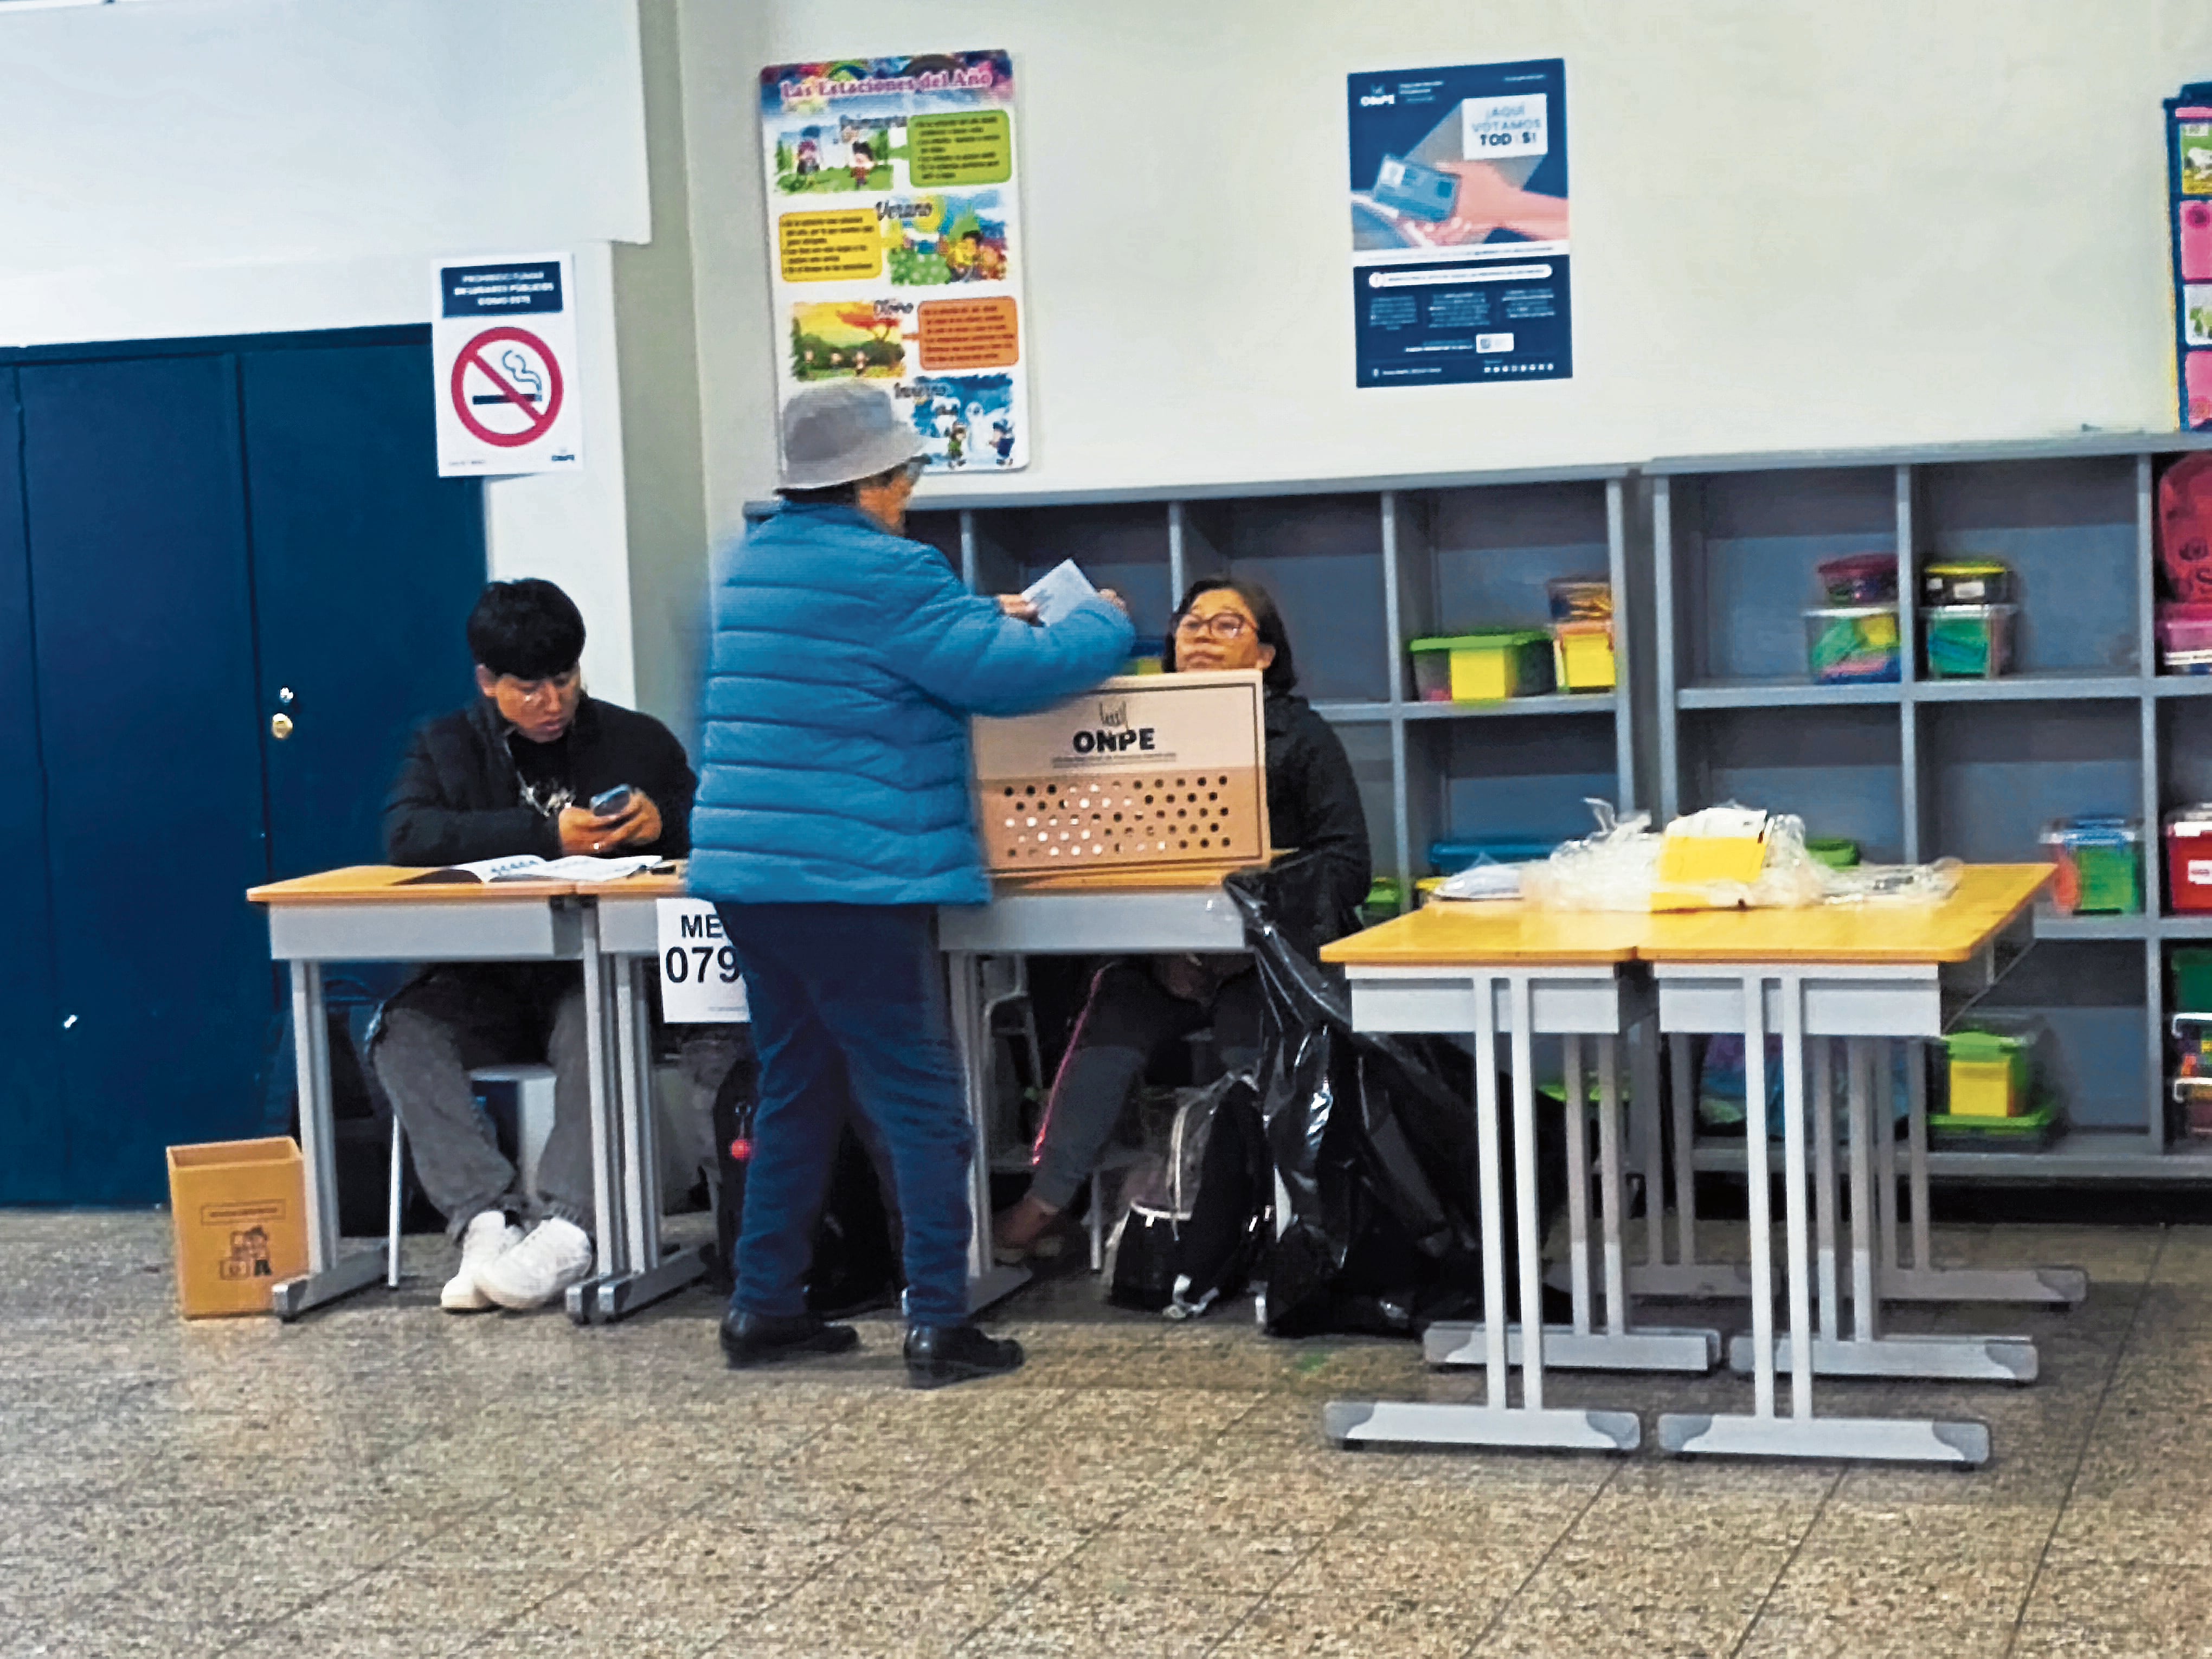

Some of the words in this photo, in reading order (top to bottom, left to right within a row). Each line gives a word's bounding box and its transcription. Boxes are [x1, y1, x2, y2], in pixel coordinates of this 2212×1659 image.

[781, 81, 812, 99] Las
[818, 76, 915, 97] Estaciones
[919, 70, 949, 91] del
[1471, 119, 1541, 132] VOTAMOS
[875, 200, 932, 222] Verano
[1073, 728, 1155, 754] ONPE
